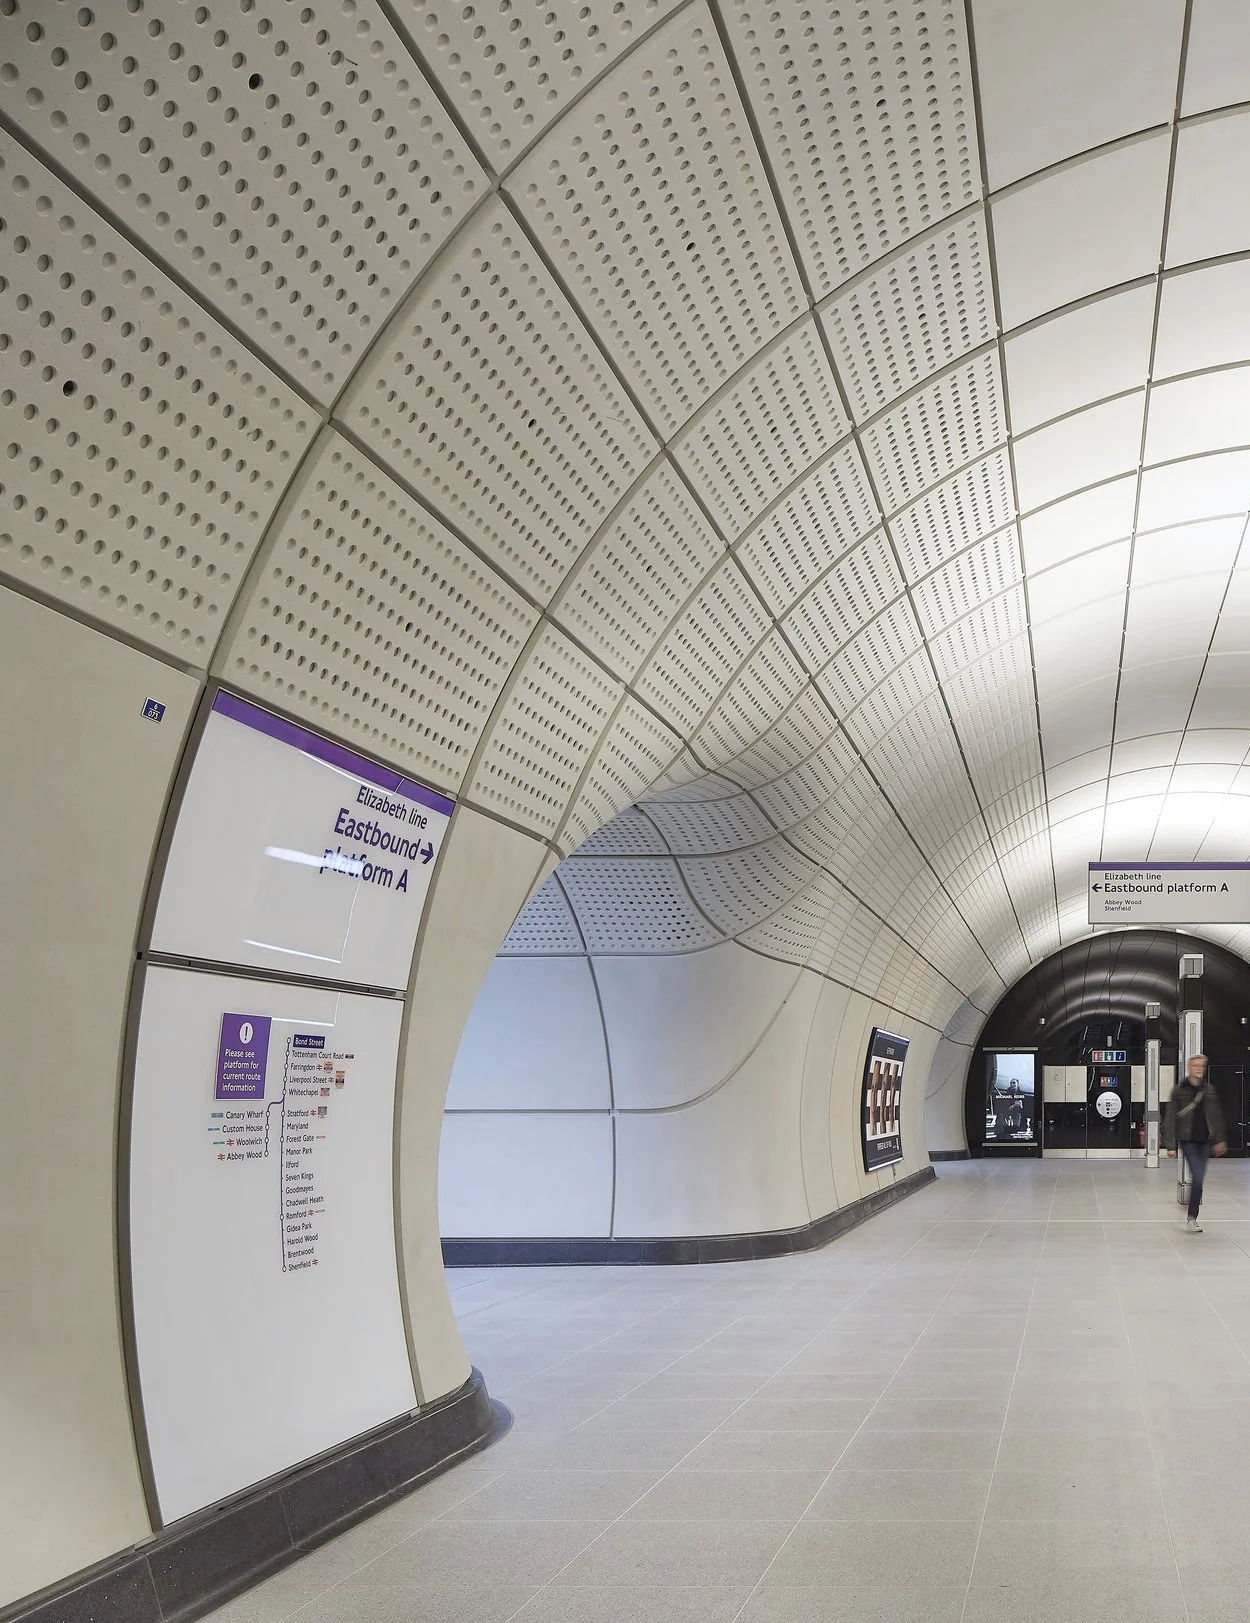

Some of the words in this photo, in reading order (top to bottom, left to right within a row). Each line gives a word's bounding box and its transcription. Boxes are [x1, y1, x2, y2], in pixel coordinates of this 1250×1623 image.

[148, 710, 158, 719] 073
[356, 786, 406, 820] Elizabeth
[408, 808, 428, 829] line
[334, 808, 421, 860] Eastbound
[396, 869, 408, 892] A
[1104, 883, 1163, 892] Eastbound
[1168, 883, 1216, 894] platform
[1220, 883, 1229, 892] A
[308, 1038, 323, 1046] Street
[225, 1049, 244, 1057] Please
[292, 1050, 317, 1058] Tottenham
[224, 1061, 249, 1070] platform
[250, 1061, 259, 1069] for
[291, 1063, 315, 1072] Farringdon
[290, 1076, 311, 1084] Liverpool
[222, 1083, 256, 1091] information
[289, 1088, 318, 1097] Whitechapel
[226, 1111, 245, 1120] Canary
[222, 1125, 244, 1133] Custom
[287, 1122, 309, 1131] Maryland
[227, 1152, 245, 1161] Abbey
[286, 1186, 313, 1194] Goodmayes
[286, 1197, 308, 1207] Chadwell
[286, 1211, 307, 1220] Romford
[302, 1222, 312, 1230] Park
[287, 1236, 303, 1245] Harold
[304, 1233, 318, 1242] Wood
[288, 1247, 314, 1258] Brentwood
[288, 1260, 311, 1271] Shenfield
